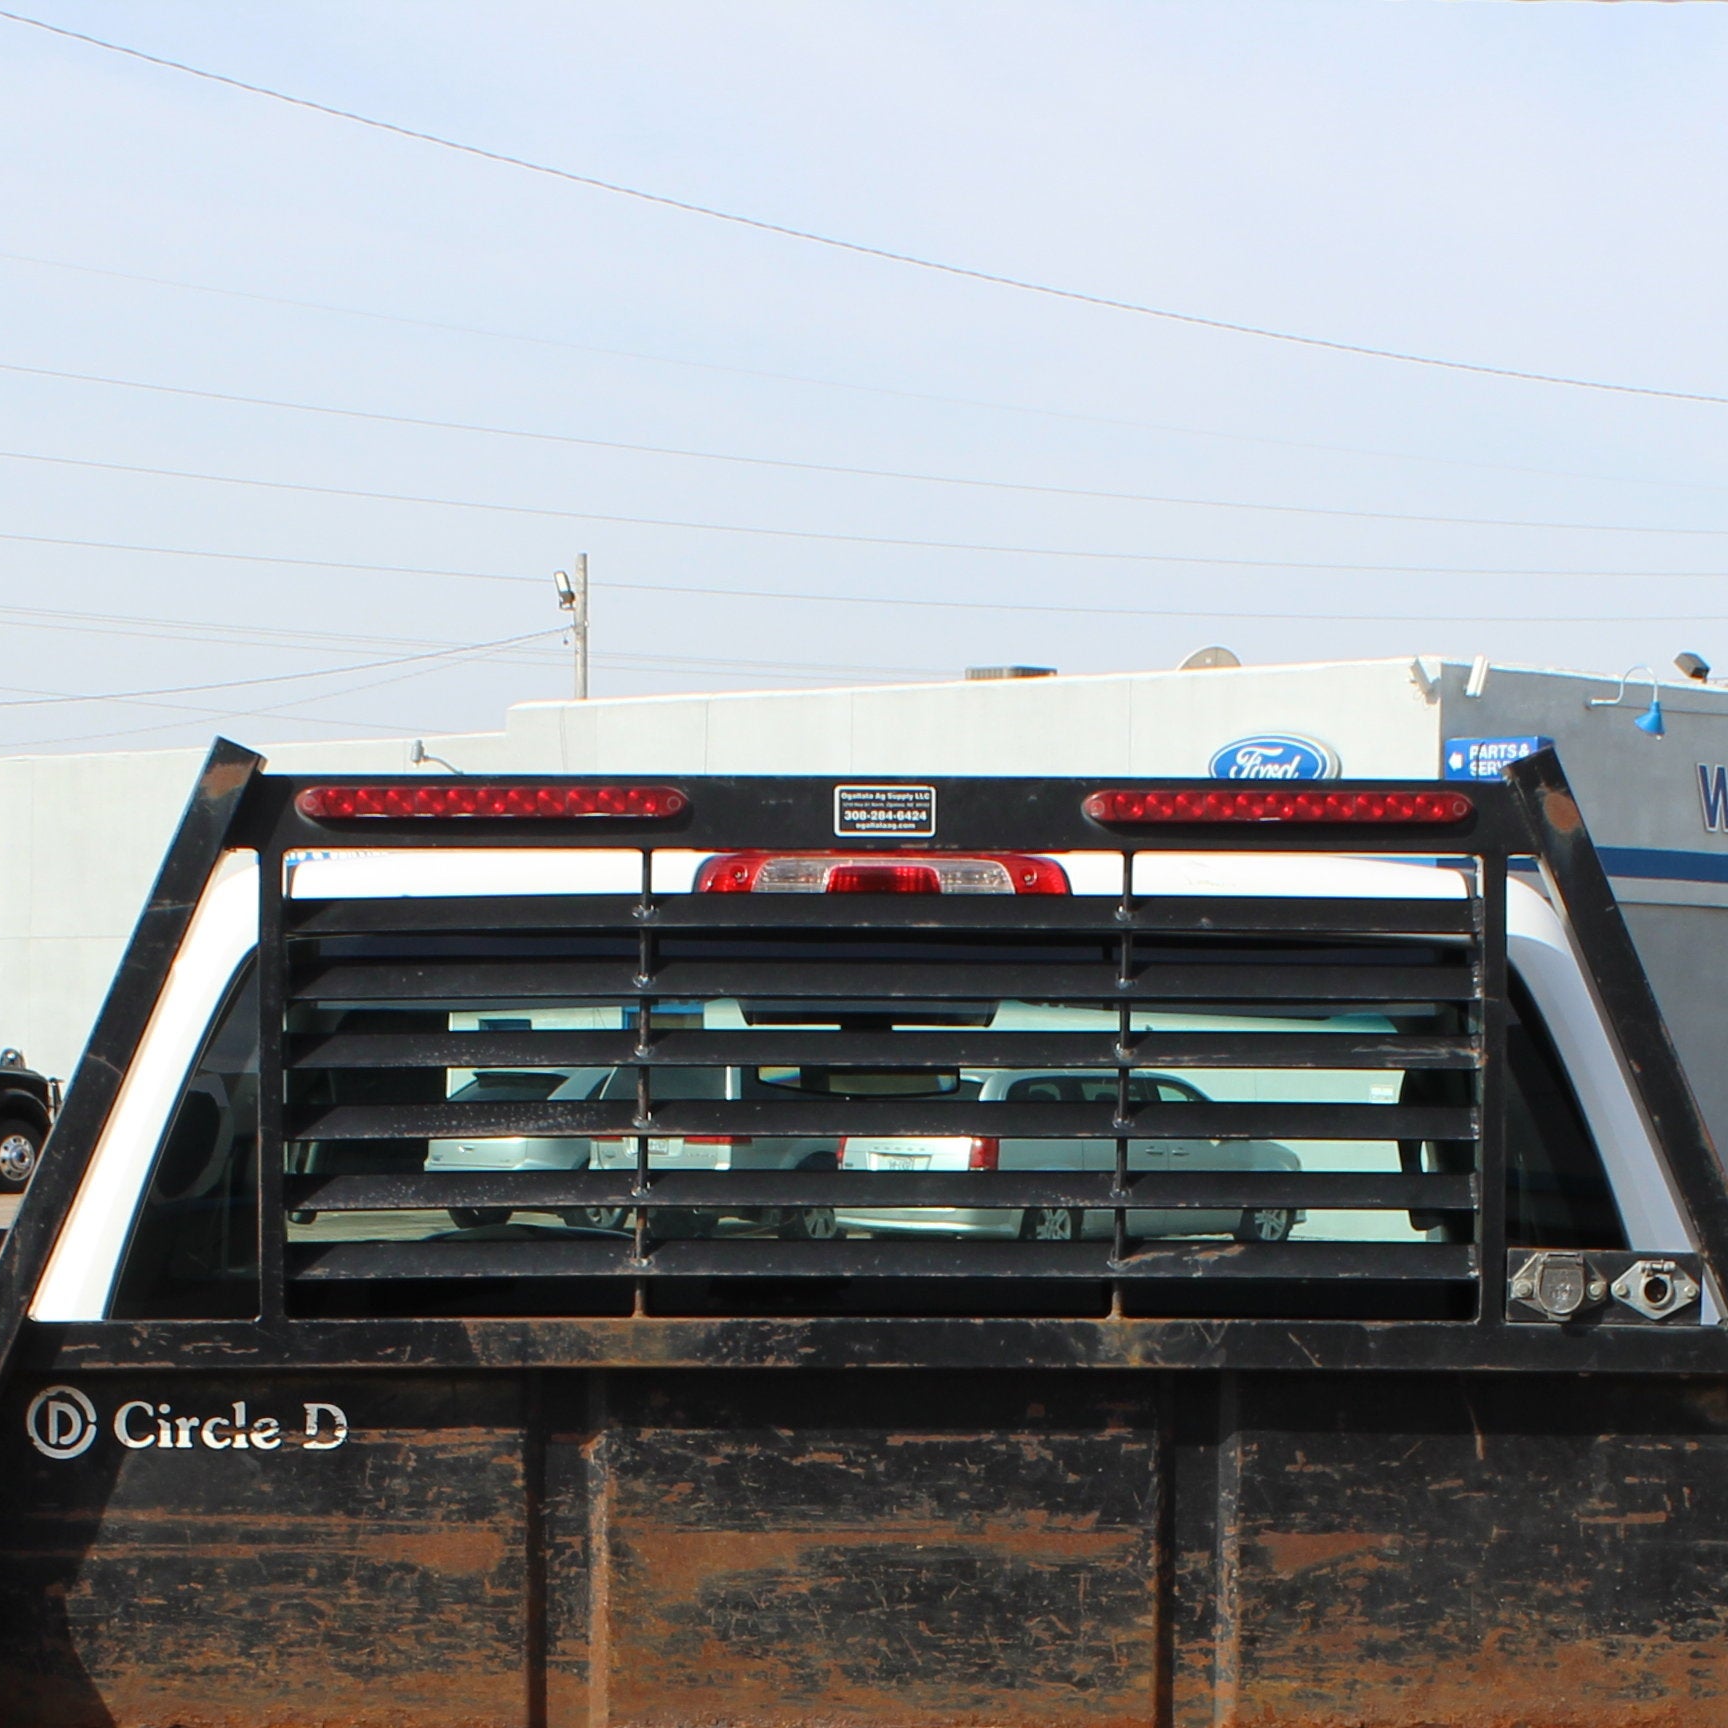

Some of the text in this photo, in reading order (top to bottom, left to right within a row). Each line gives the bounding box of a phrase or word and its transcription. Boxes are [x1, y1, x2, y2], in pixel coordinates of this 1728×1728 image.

[1469, 744, 1517, 760] PARTS
[113, 1400, 349, 1449] Circle D
